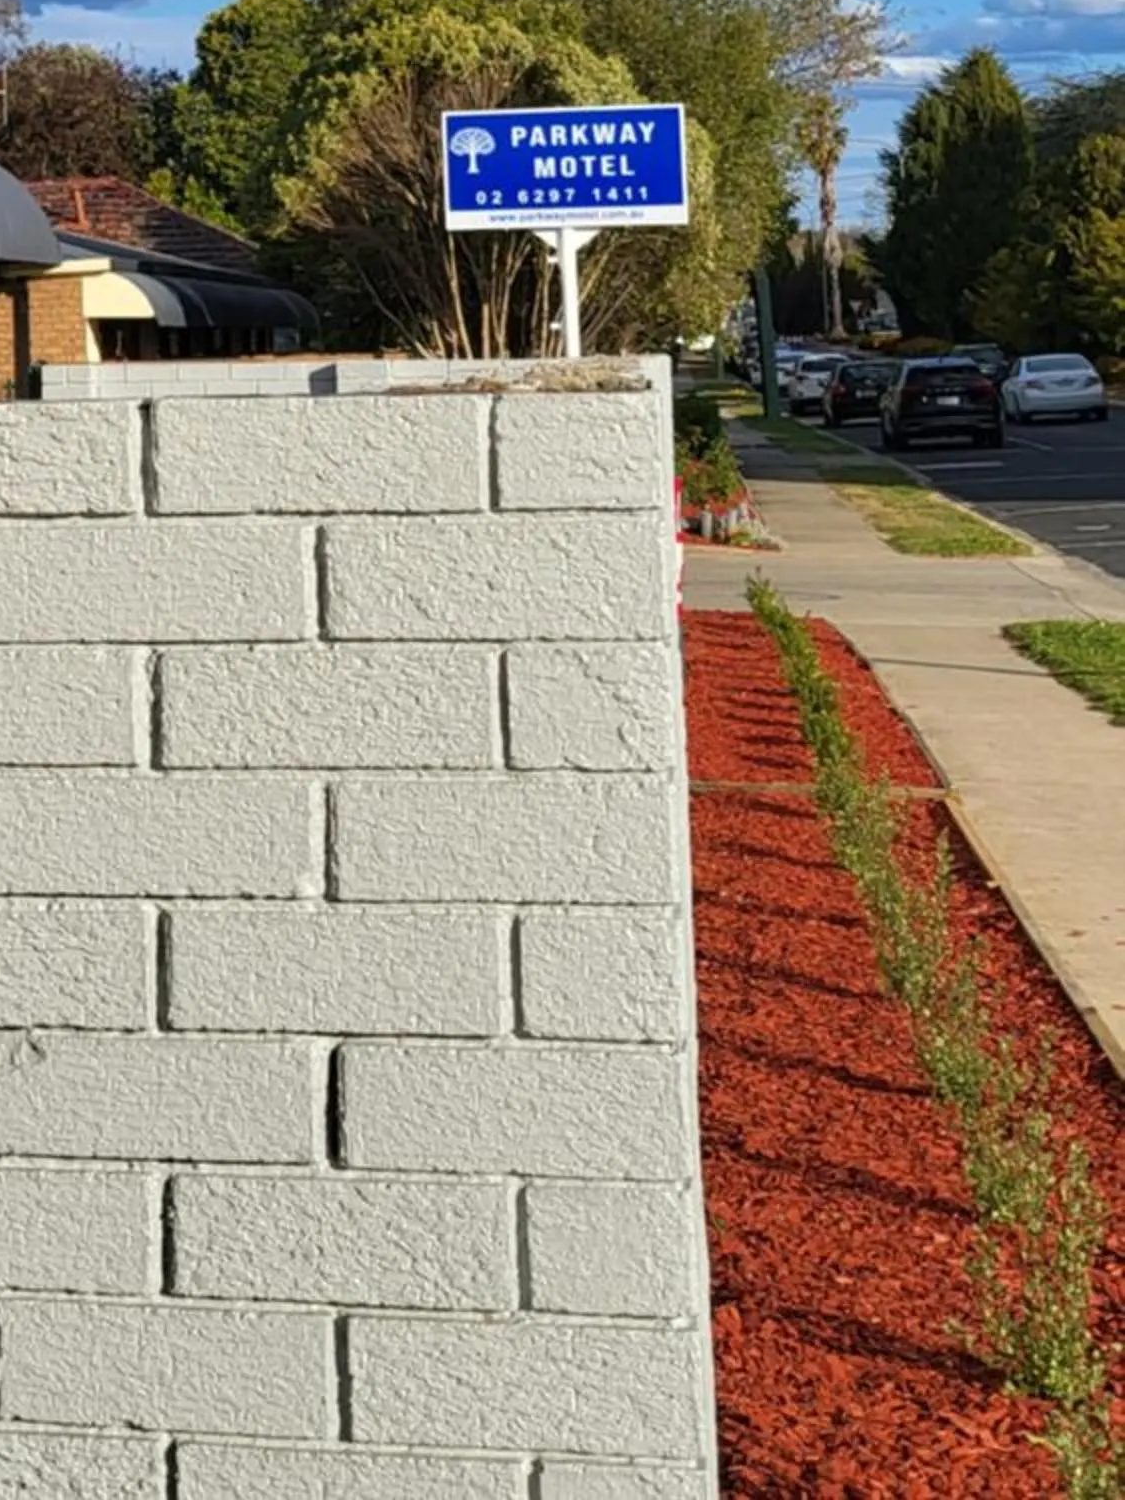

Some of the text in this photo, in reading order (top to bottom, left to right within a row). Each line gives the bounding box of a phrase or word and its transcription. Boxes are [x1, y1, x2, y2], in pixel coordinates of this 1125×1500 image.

[511, 122, 655, 147] PARKWAY
[534, 155, 635, 178] MOTEL
[475, 186, 649, 205] 02 6297 1411
